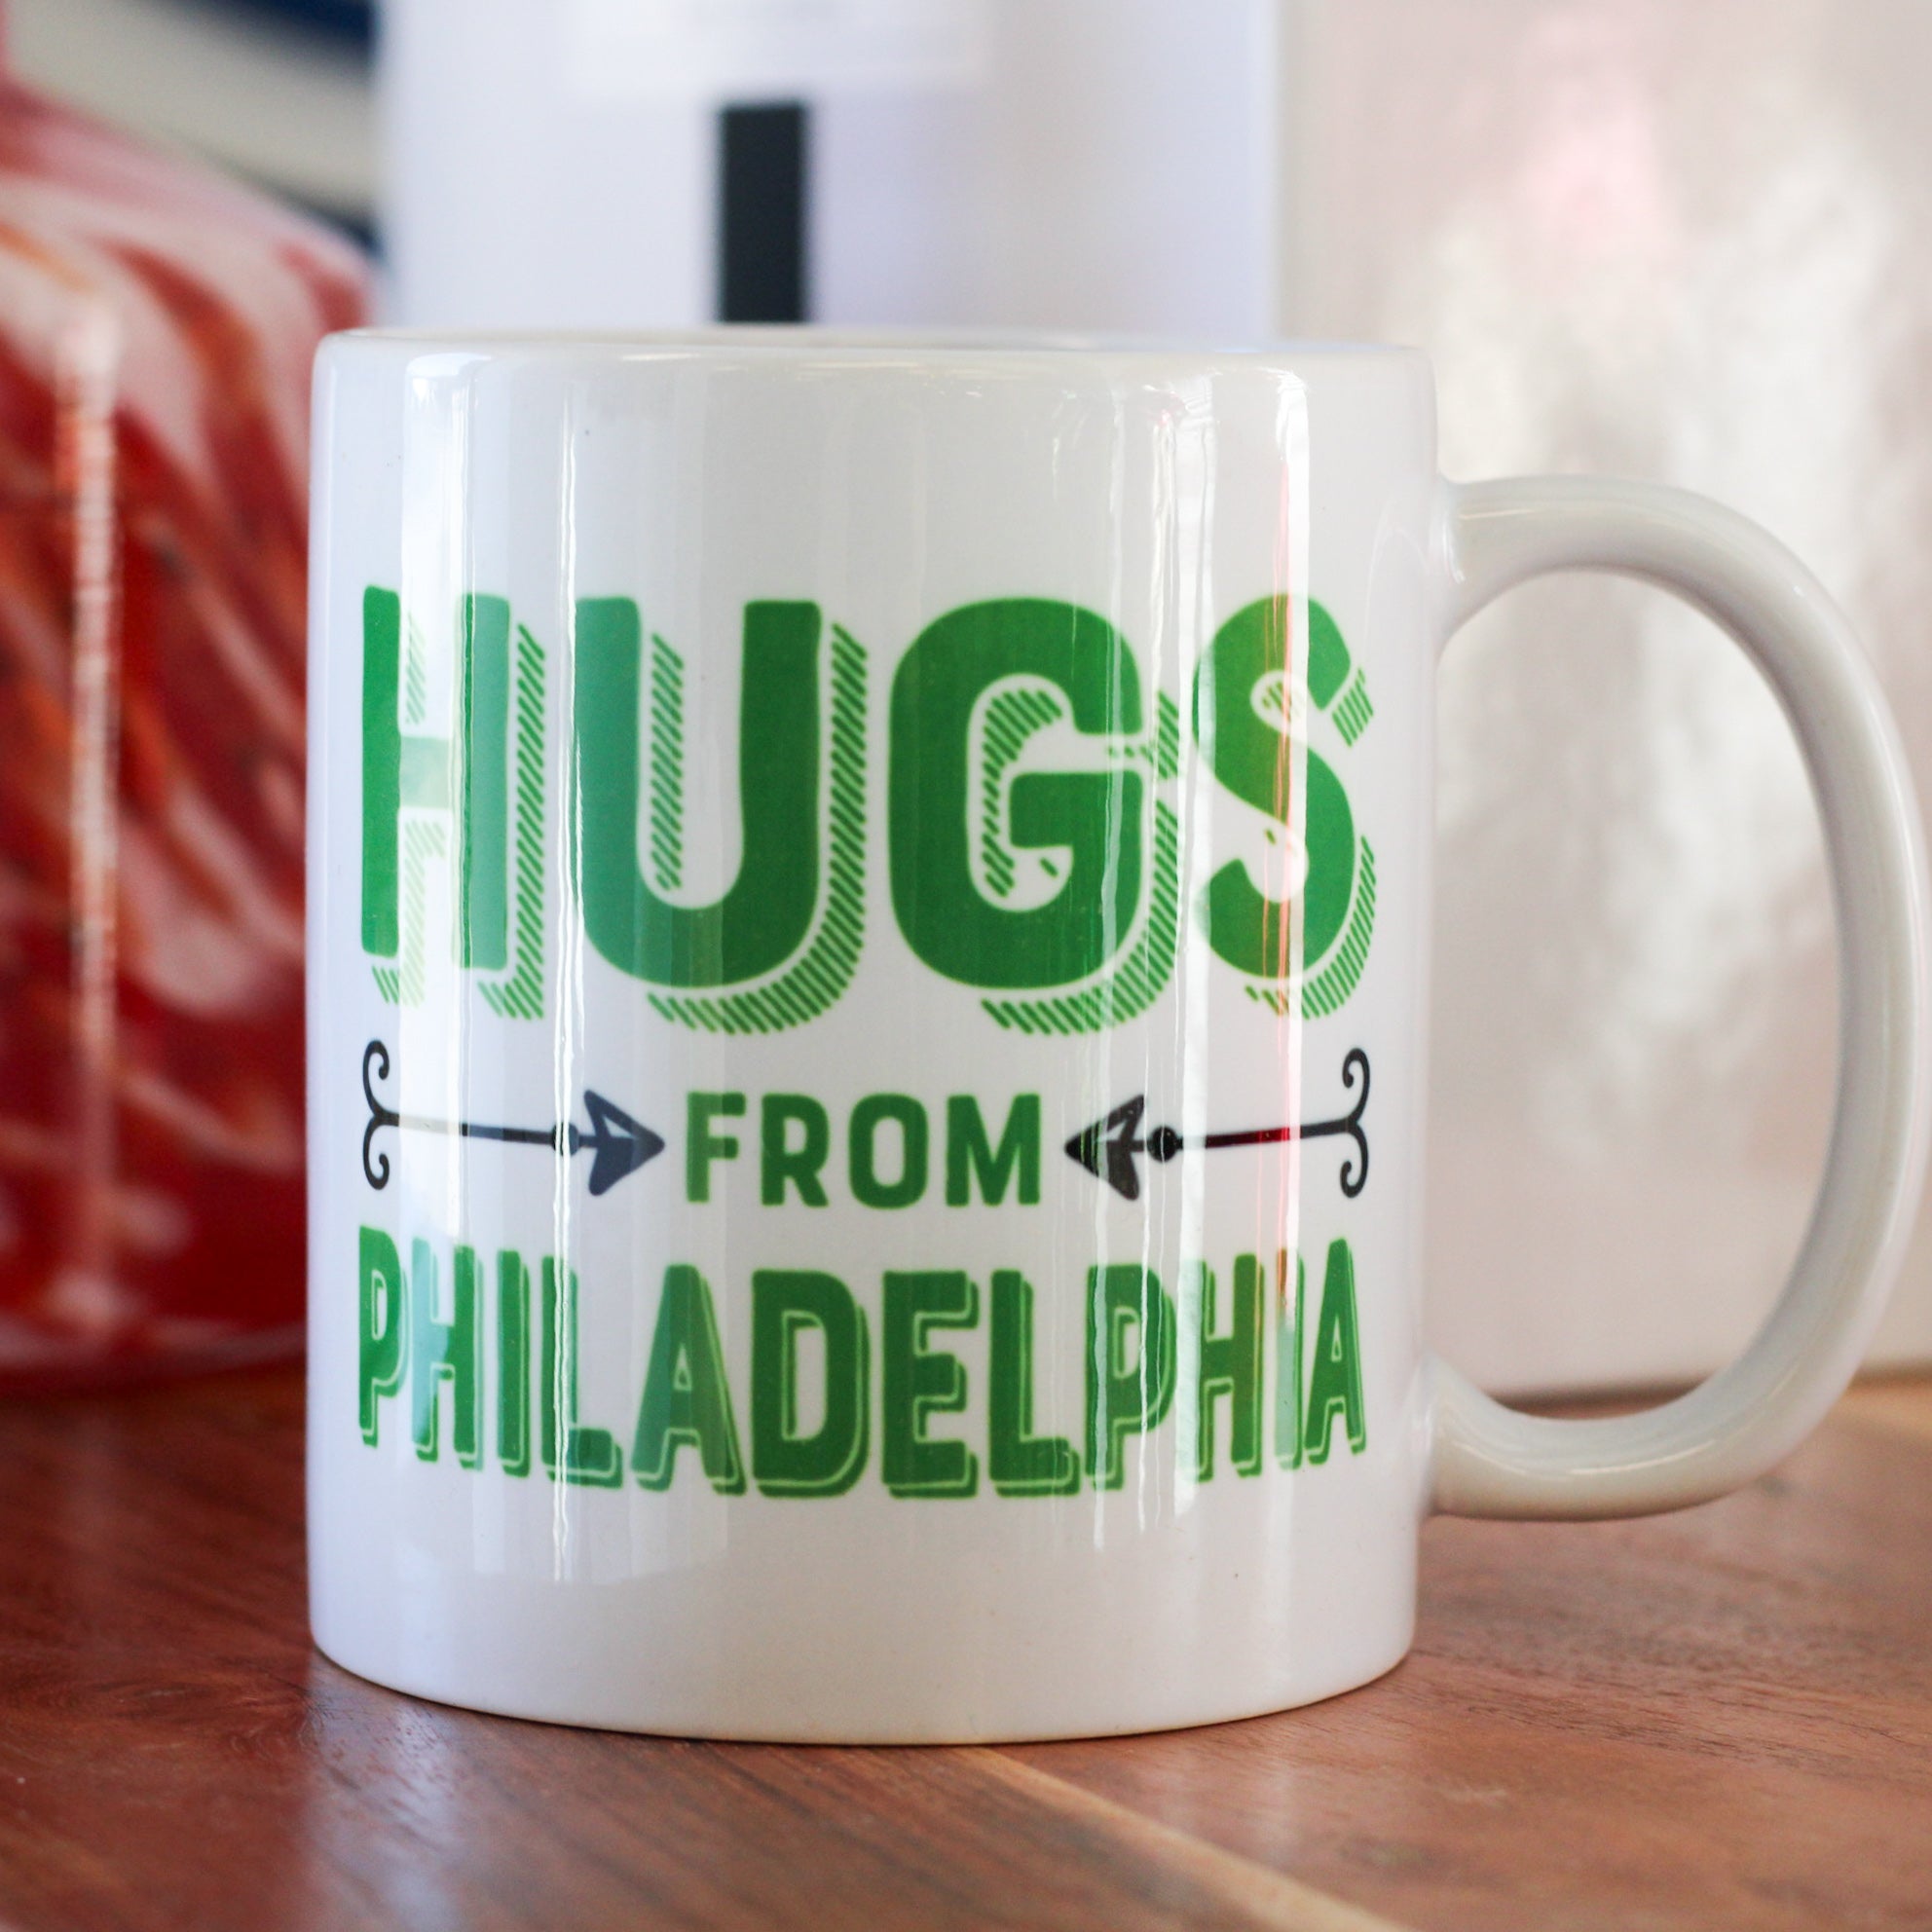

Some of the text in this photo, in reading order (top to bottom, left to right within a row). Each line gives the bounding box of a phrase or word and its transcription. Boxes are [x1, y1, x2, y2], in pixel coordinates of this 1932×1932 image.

[360, 584, 1376, 1035] HUGS
[685, 1090, 1043, 1209] FROM
[357, 1224, 1367, 1500] PHILADELPHIA
